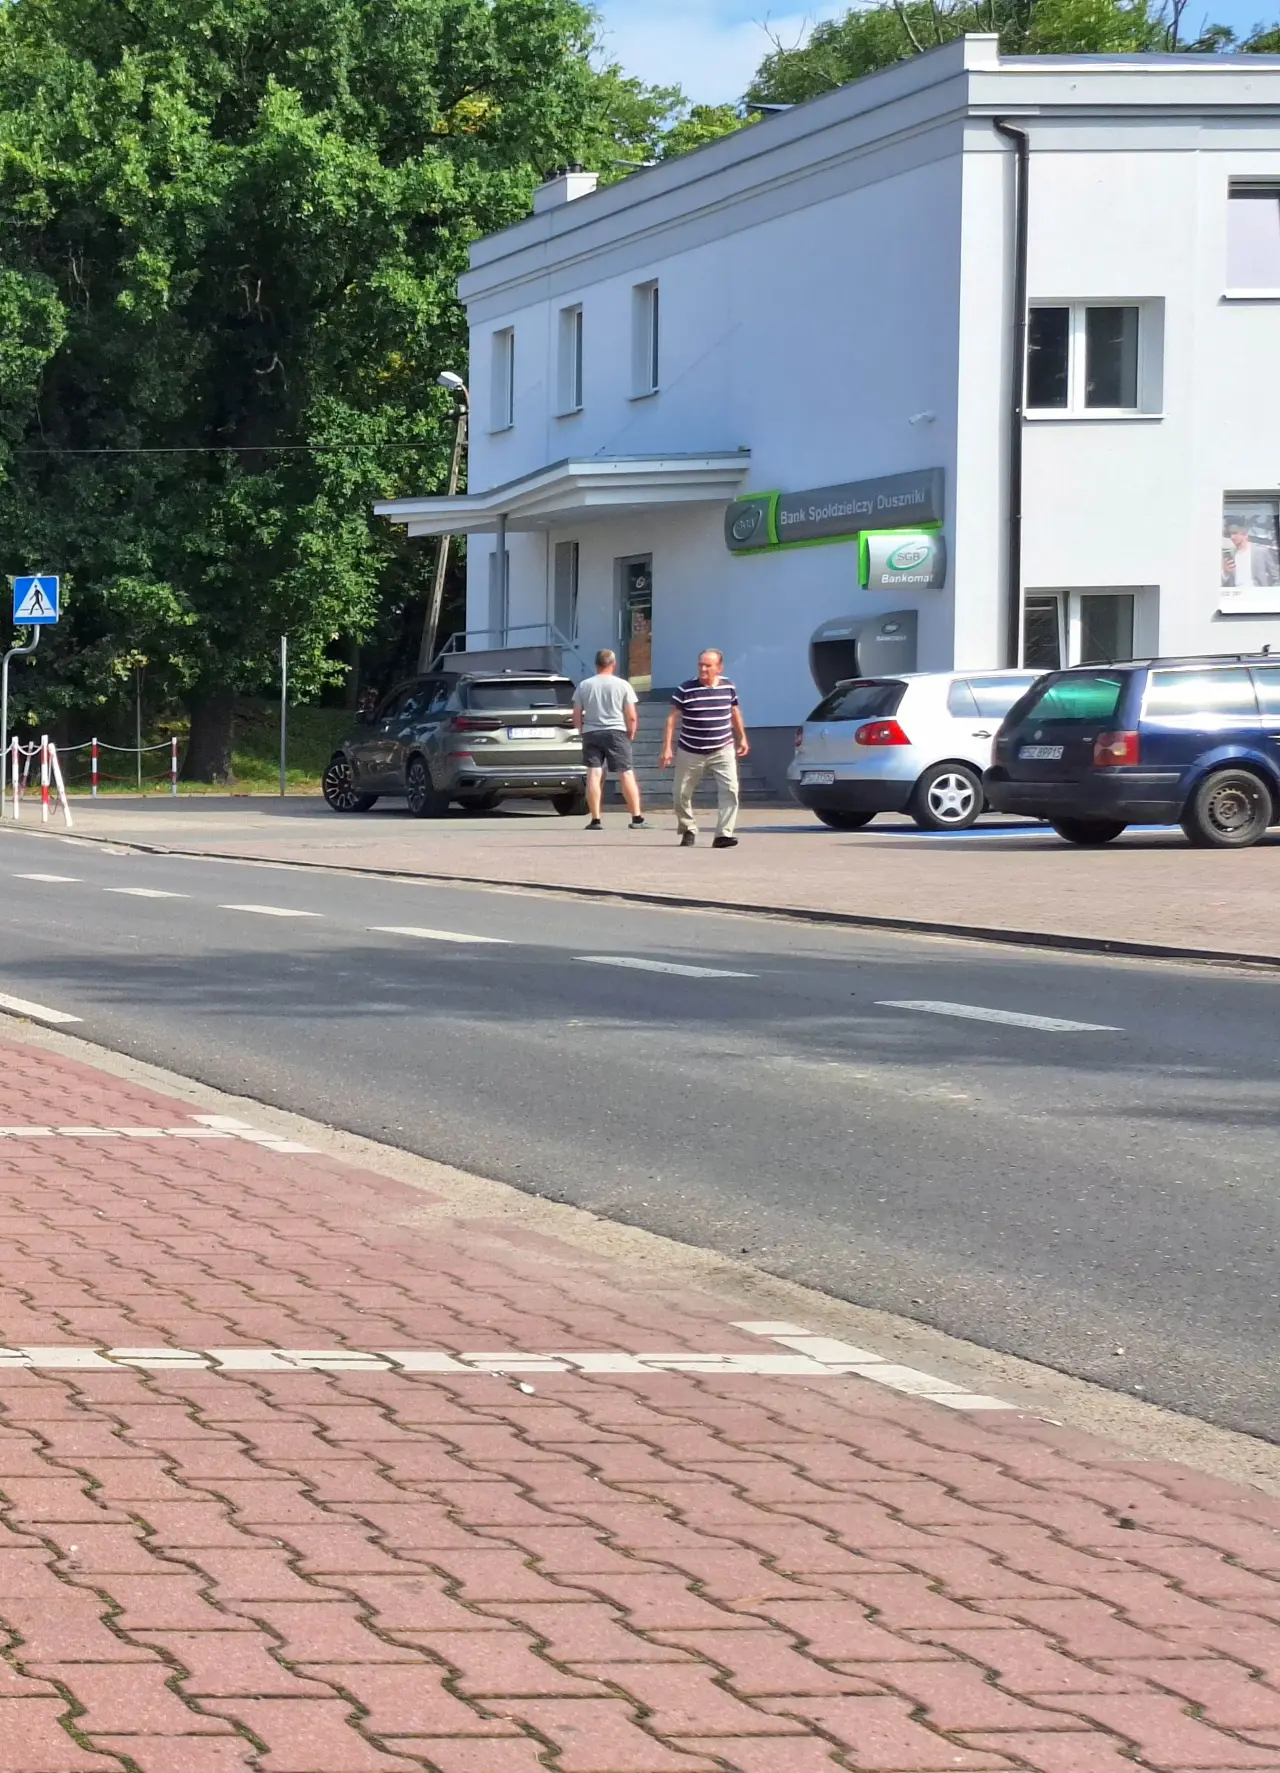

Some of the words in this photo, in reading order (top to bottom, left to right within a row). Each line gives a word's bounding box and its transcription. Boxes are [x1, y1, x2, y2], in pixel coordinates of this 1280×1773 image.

[781, 509, 806, 525] Bank
[877, 490, 925, 509] Duszniki
[897, 552, 921, 561] SGB
[881, 574, 934, 584] Bankomat
